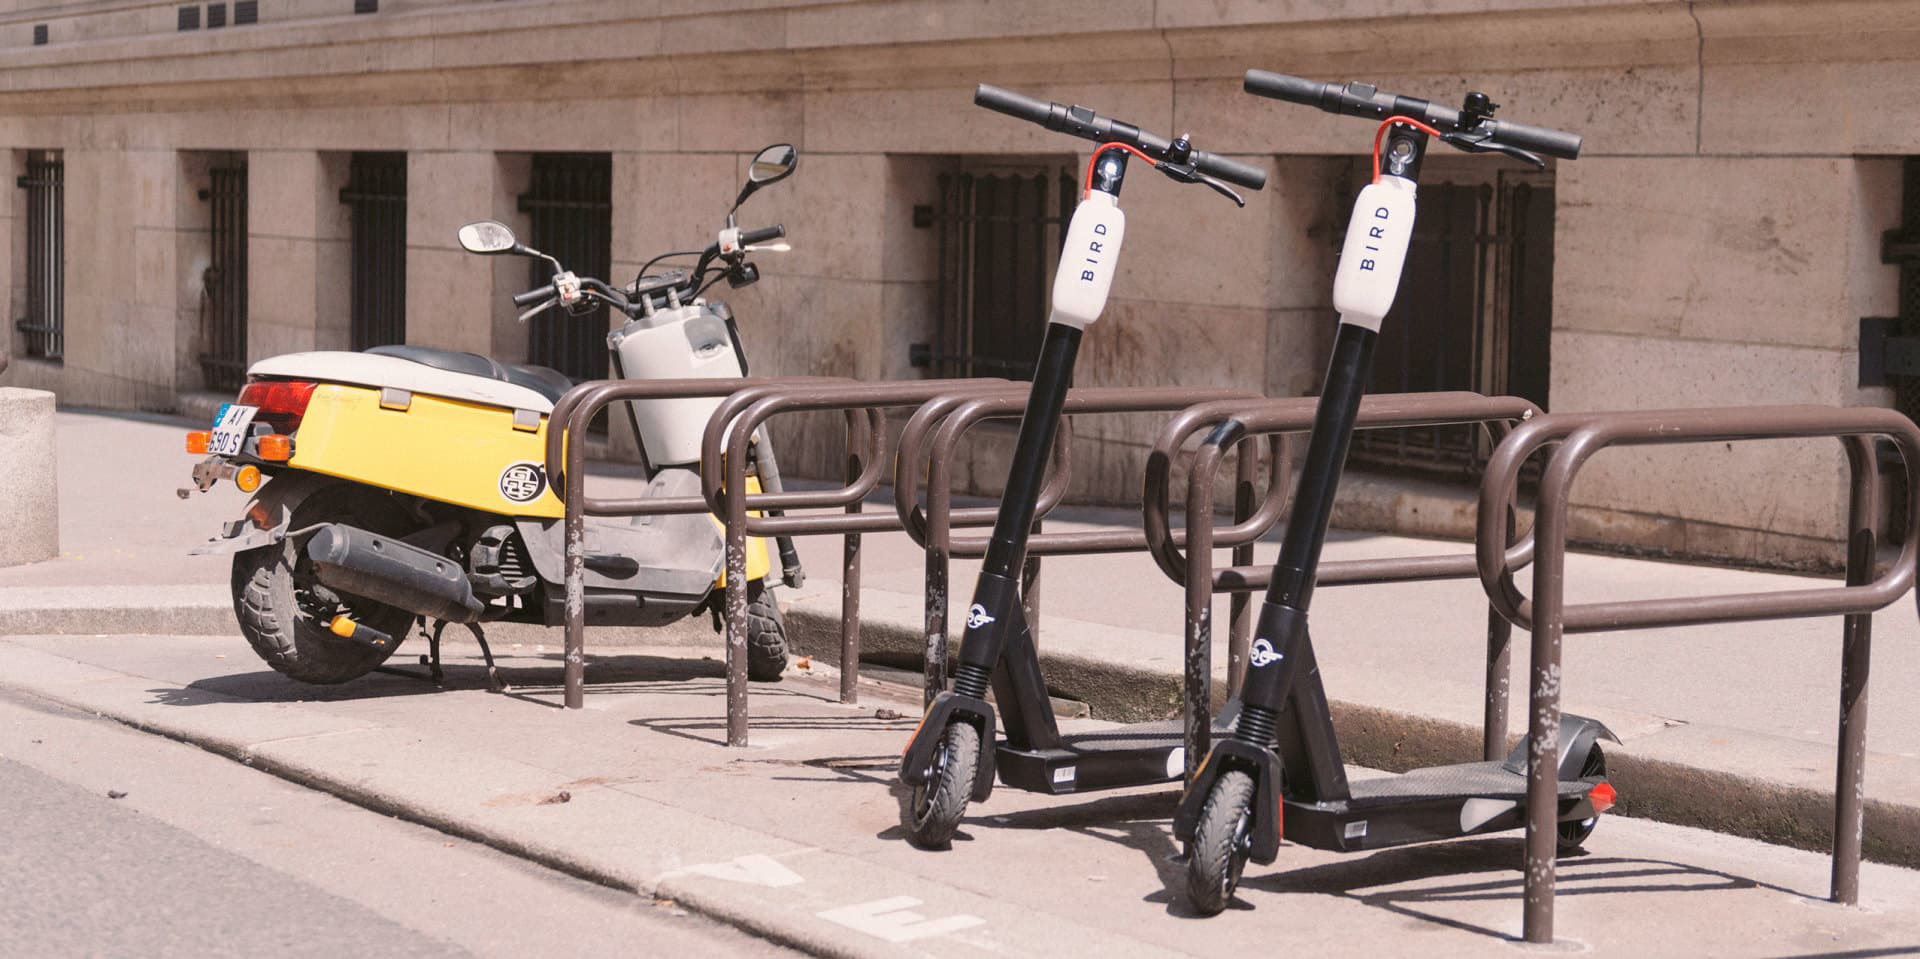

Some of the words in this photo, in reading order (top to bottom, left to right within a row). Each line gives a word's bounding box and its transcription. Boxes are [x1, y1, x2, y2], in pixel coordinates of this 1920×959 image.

[1081, 223, 1107, 281] BIRD
[1359, 207, 1390, 271] BIRD
[228, 407, 248, 426] AY
